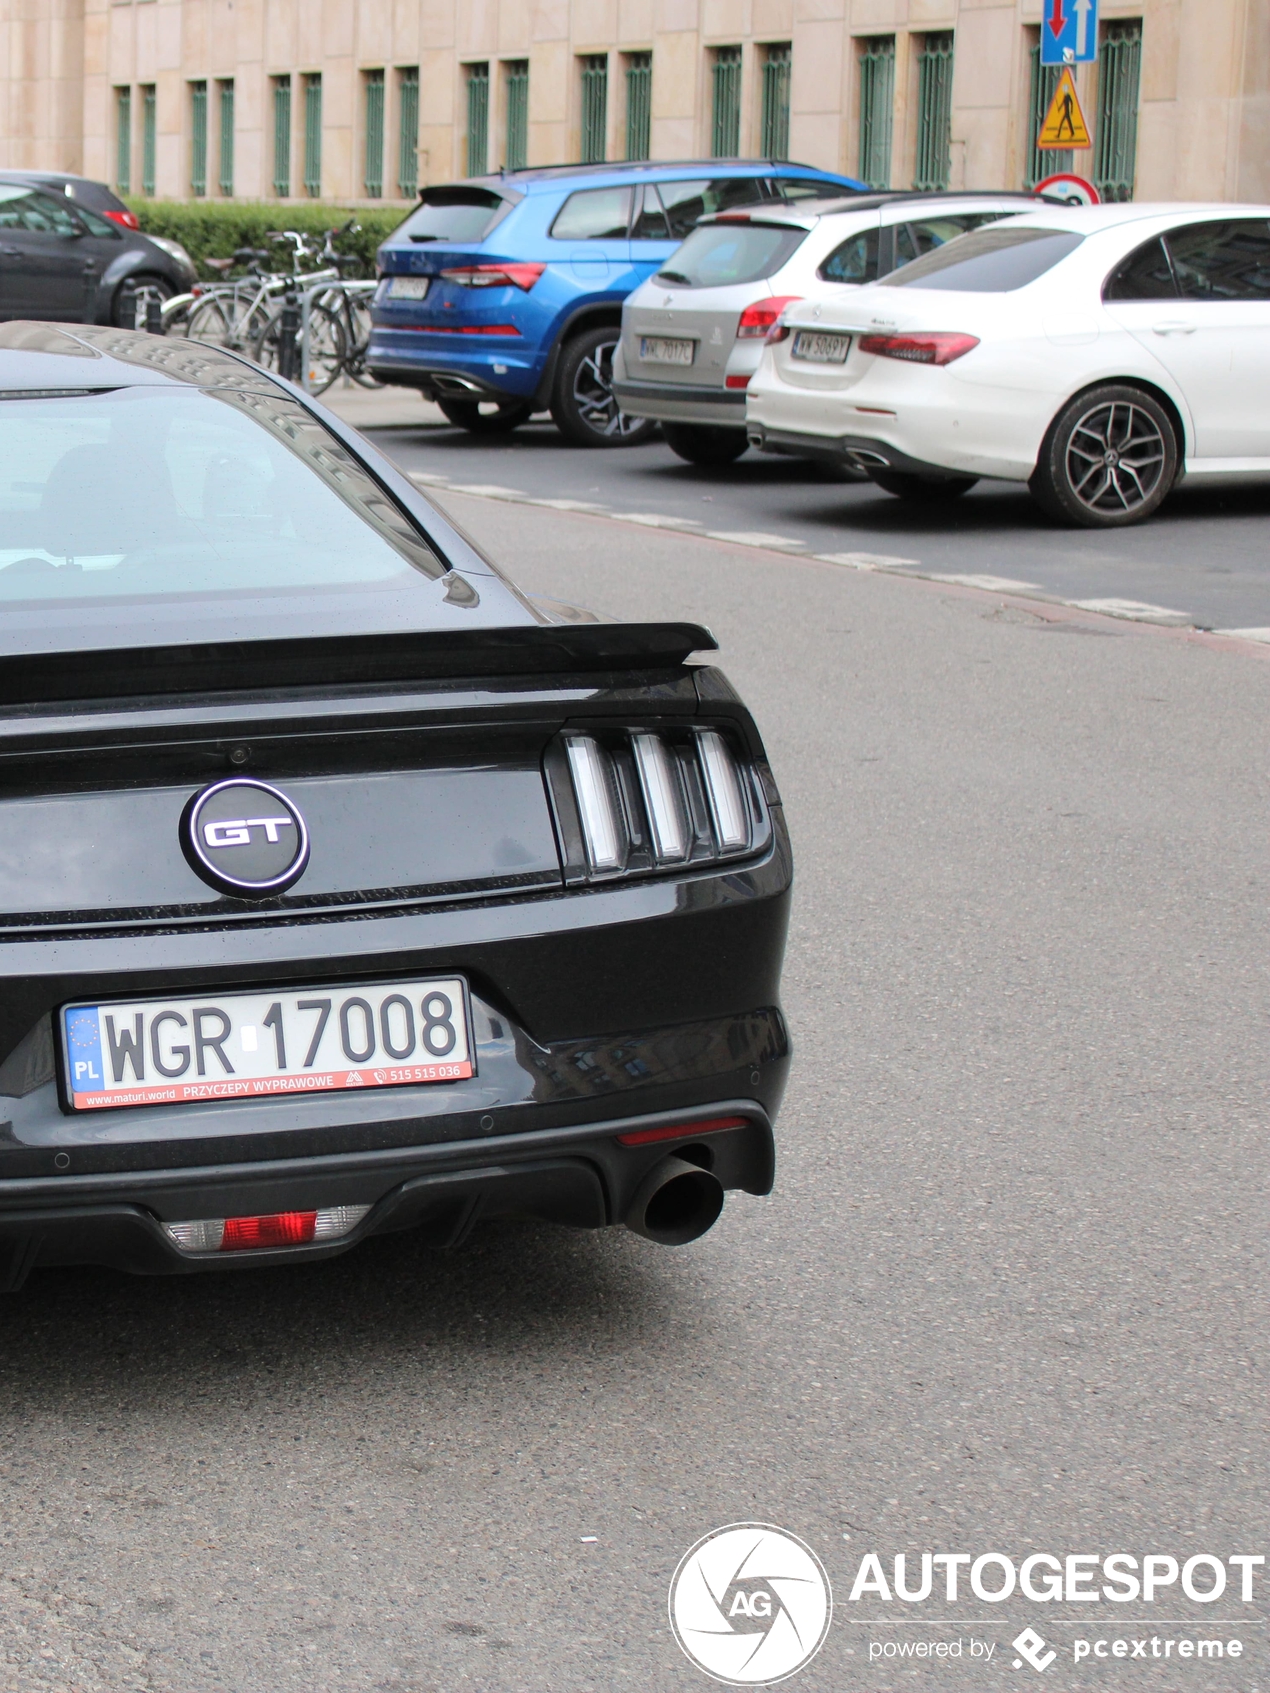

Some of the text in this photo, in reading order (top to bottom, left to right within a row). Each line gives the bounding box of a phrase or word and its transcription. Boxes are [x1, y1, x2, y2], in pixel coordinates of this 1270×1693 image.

[203, 817, 292, 848] GT
[105, 990, 457, 1082] WGR 17008
[75, 1061, 99, 1080] PL
[390, 1066, 460, 1081] 515 515 036
[86, 1075, 334, 1105] www.maturi.world PRZYCZEPY WYPRAWOWE
